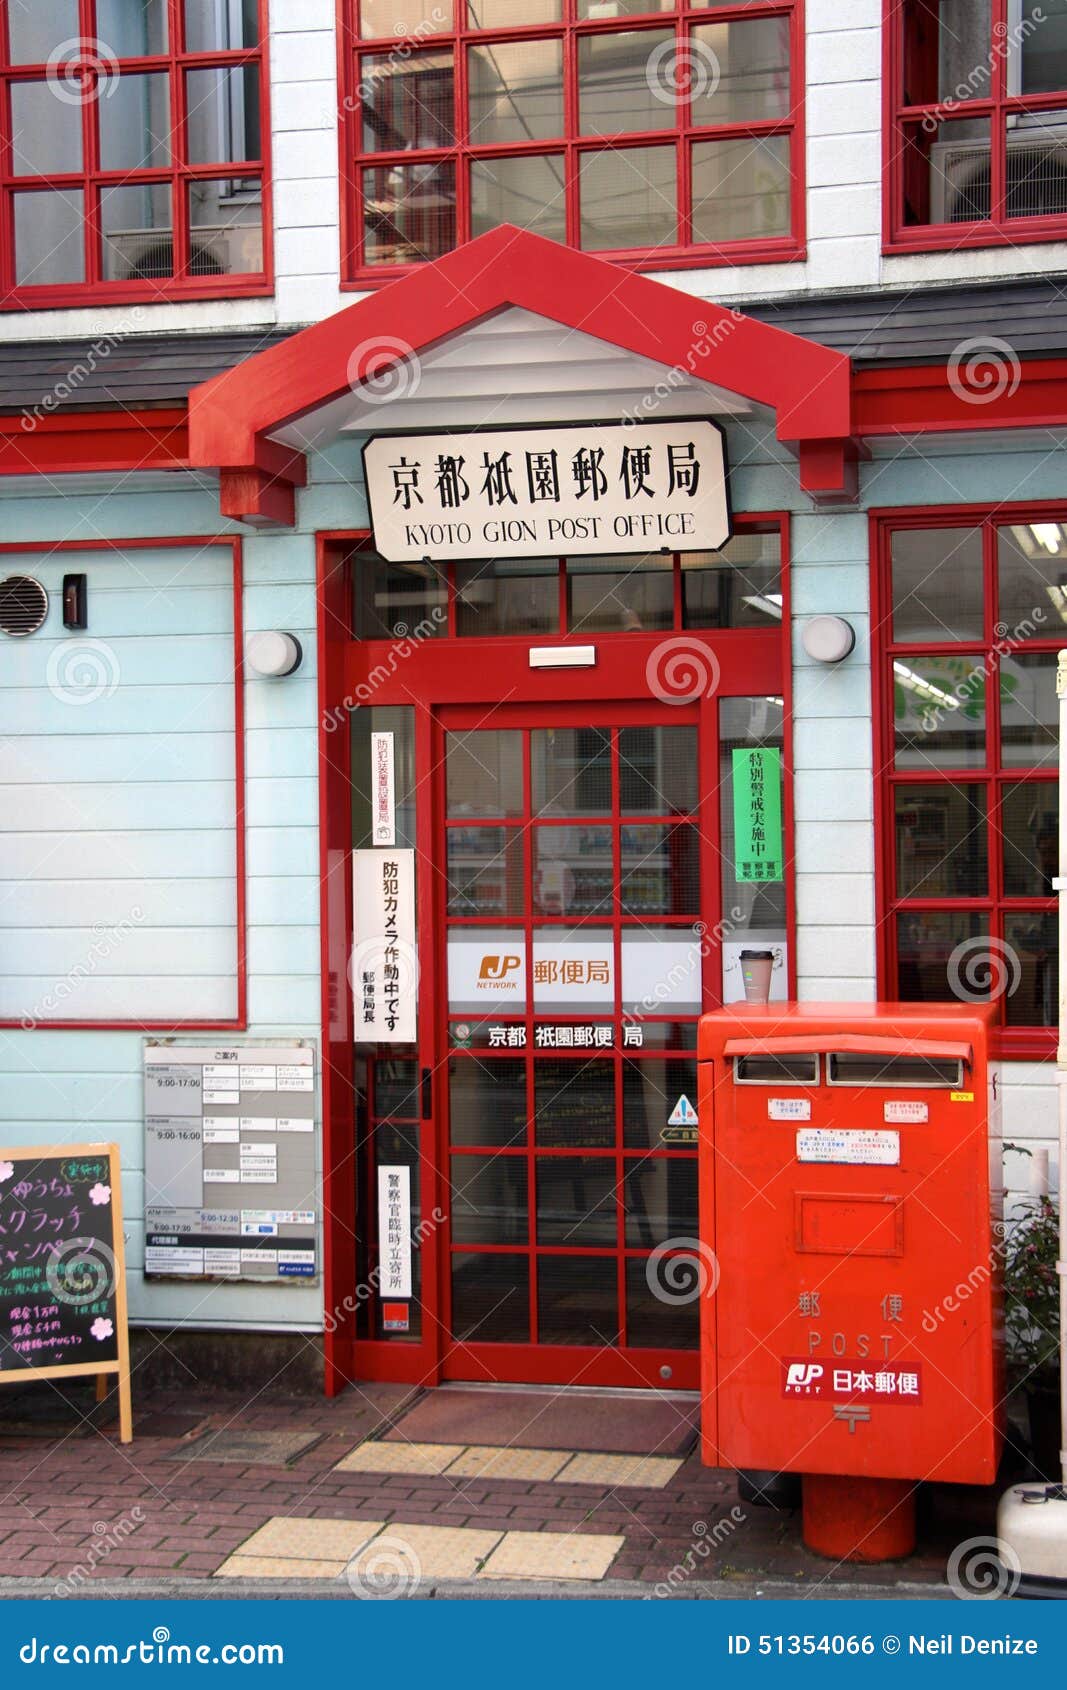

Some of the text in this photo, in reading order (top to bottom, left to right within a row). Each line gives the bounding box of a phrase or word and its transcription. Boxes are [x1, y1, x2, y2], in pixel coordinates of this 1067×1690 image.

[388, 441, 701, 510] 京都祇園郵便局
[405, 512, 696, 546] KYOTO GION POST OFFICE
[749, 752, 766, 857] 特別警戒実施中
[382, 861, 400, 1032] 防犯カメラ作動中です
[479, 955, 521, 979] JP
[534, 959, 610, 985] 郵便局
[362, 971, 376, 1023] 郵便局長
[476, 981, 518, 989] NETWORK
[215, 1051, 239, 1060] ご案内
[157, 1079, 201, 1088] 9:00-17:00
[157, 1131, 201, 1140] 9:00-16:00
[808, 1331, 893, 1358] POST
[787, 1363, 824, 1384] JP
[833, 1369, 919, 1395] 日本郵便
[785, 1385, 821, 1393] POST
